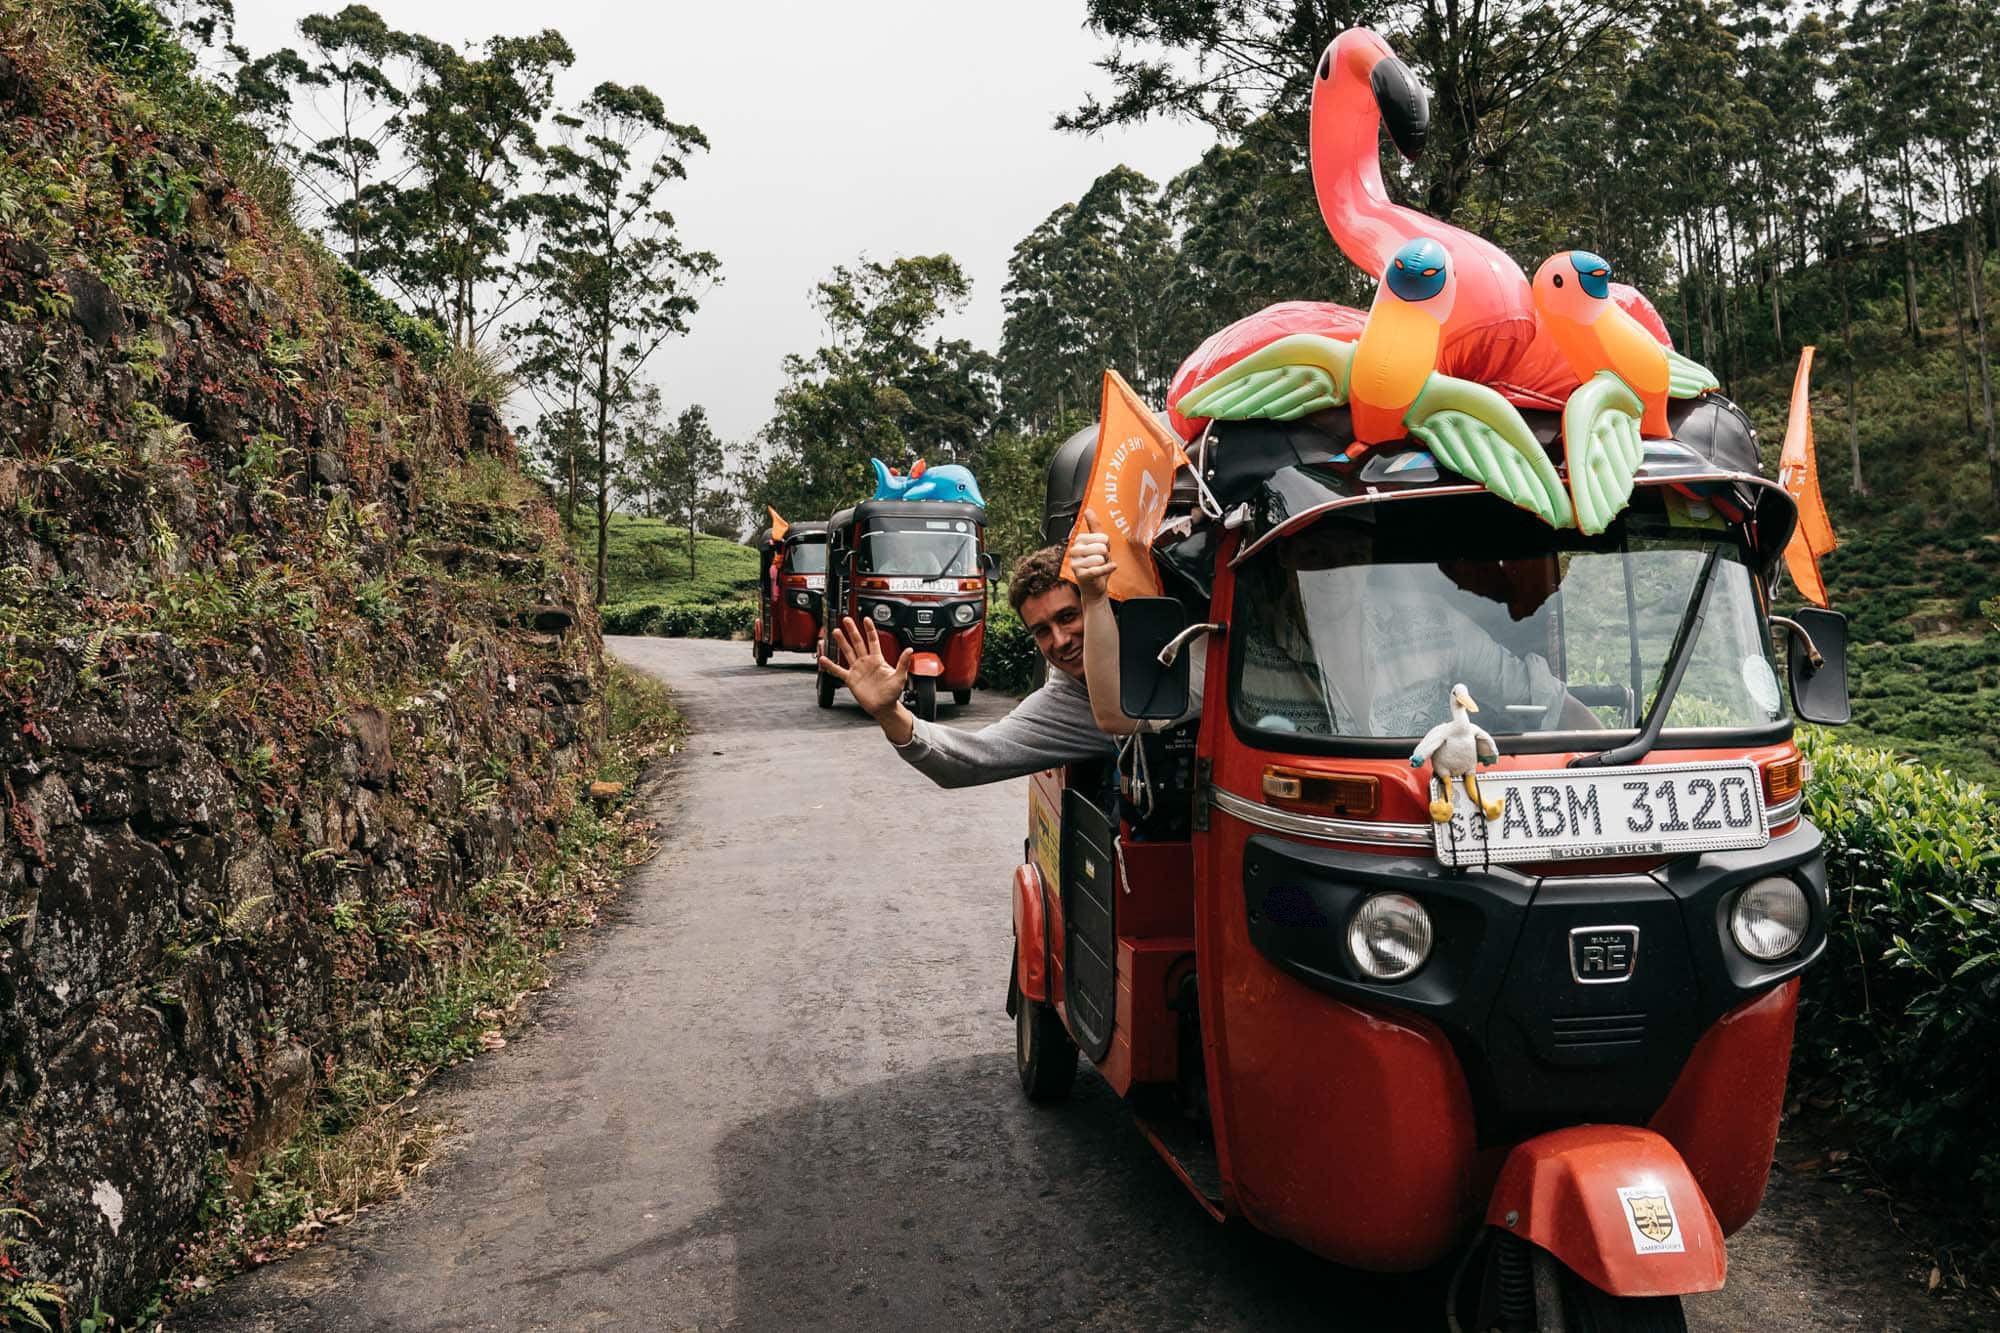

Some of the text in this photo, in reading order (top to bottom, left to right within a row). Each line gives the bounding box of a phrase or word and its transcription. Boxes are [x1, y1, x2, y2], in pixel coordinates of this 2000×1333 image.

[1502, 783, 1602, 839] ABM
[1623, 776, 1753, 832] 3120
[1561, 843, 1655, 857] GOOD LUCK
[1583, 944, 1627, 972] RE
